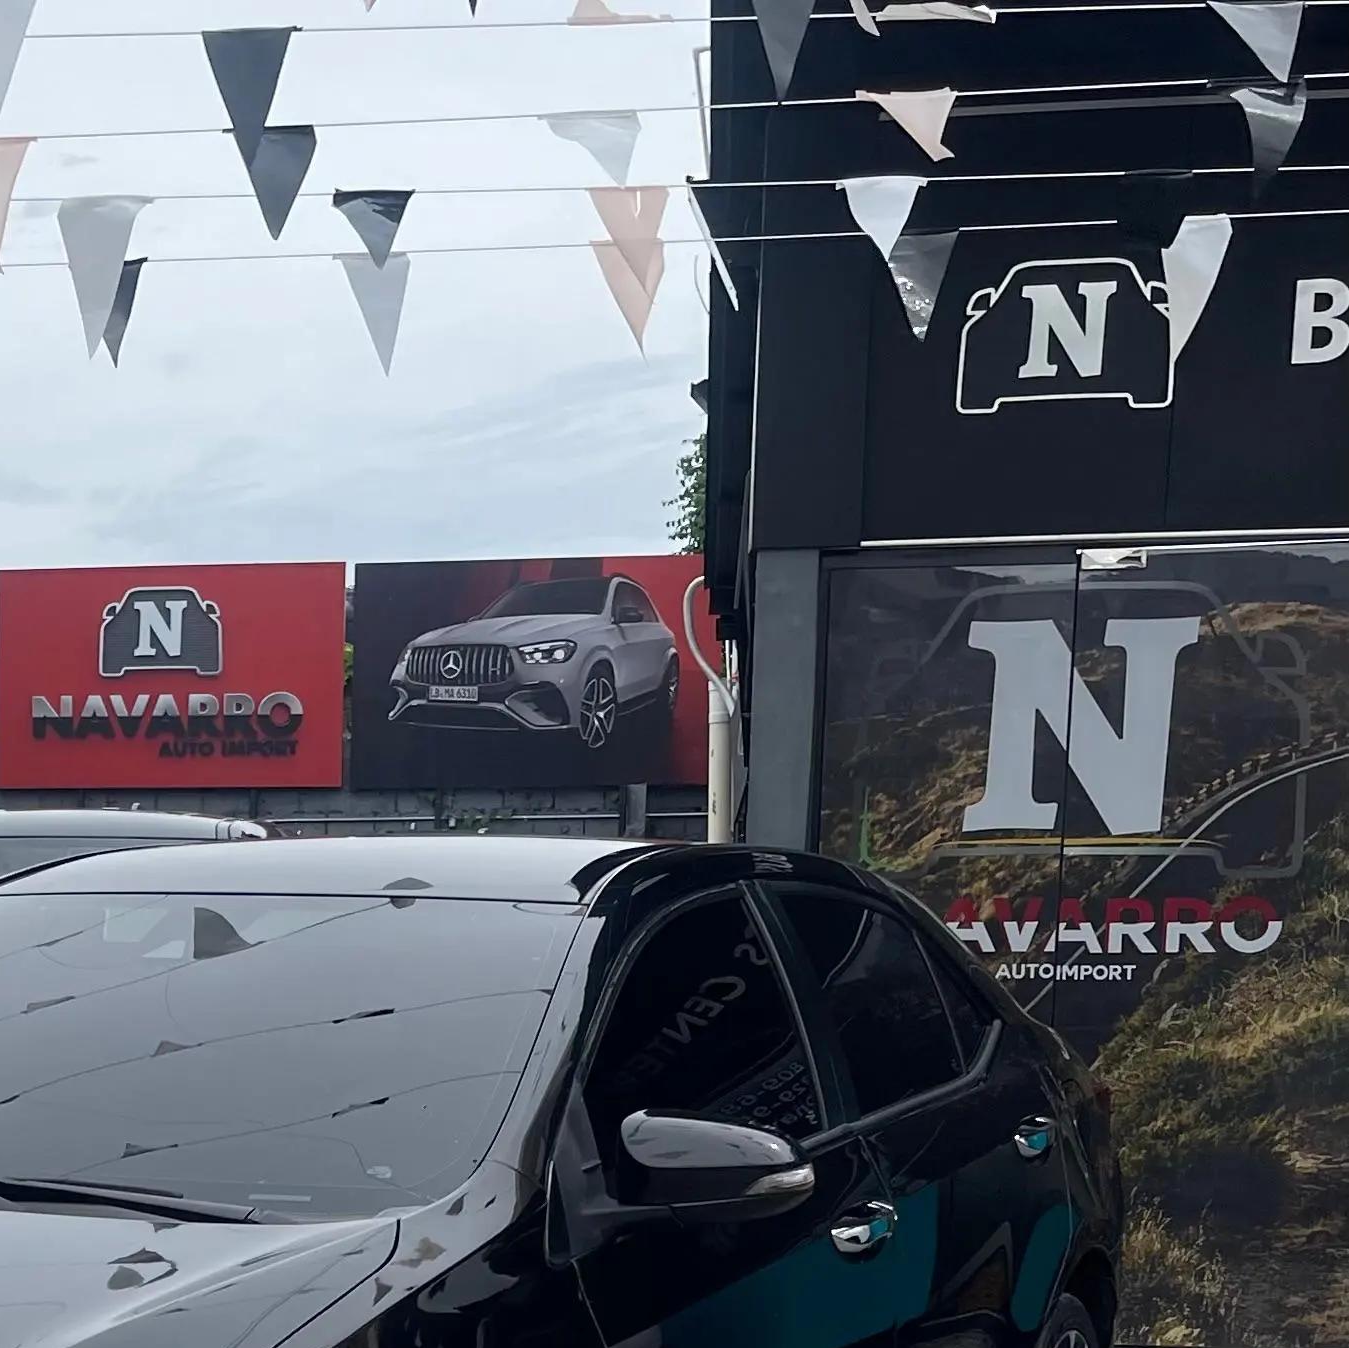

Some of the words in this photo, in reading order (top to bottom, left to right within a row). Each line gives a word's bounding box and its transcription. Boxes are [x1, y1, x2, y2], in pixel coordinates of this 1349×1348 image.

[1018, 280, 1117, 378] N
[132, 599, 188, 657] N
[31, 691, 304, 740] NAVARRO
[962, 615, 1202, 836] N
[157, 740, 214, 758] AUTO
[220, 739, 299, 758] IMPORT
[943, 894, 1284, 954] AVARRO
